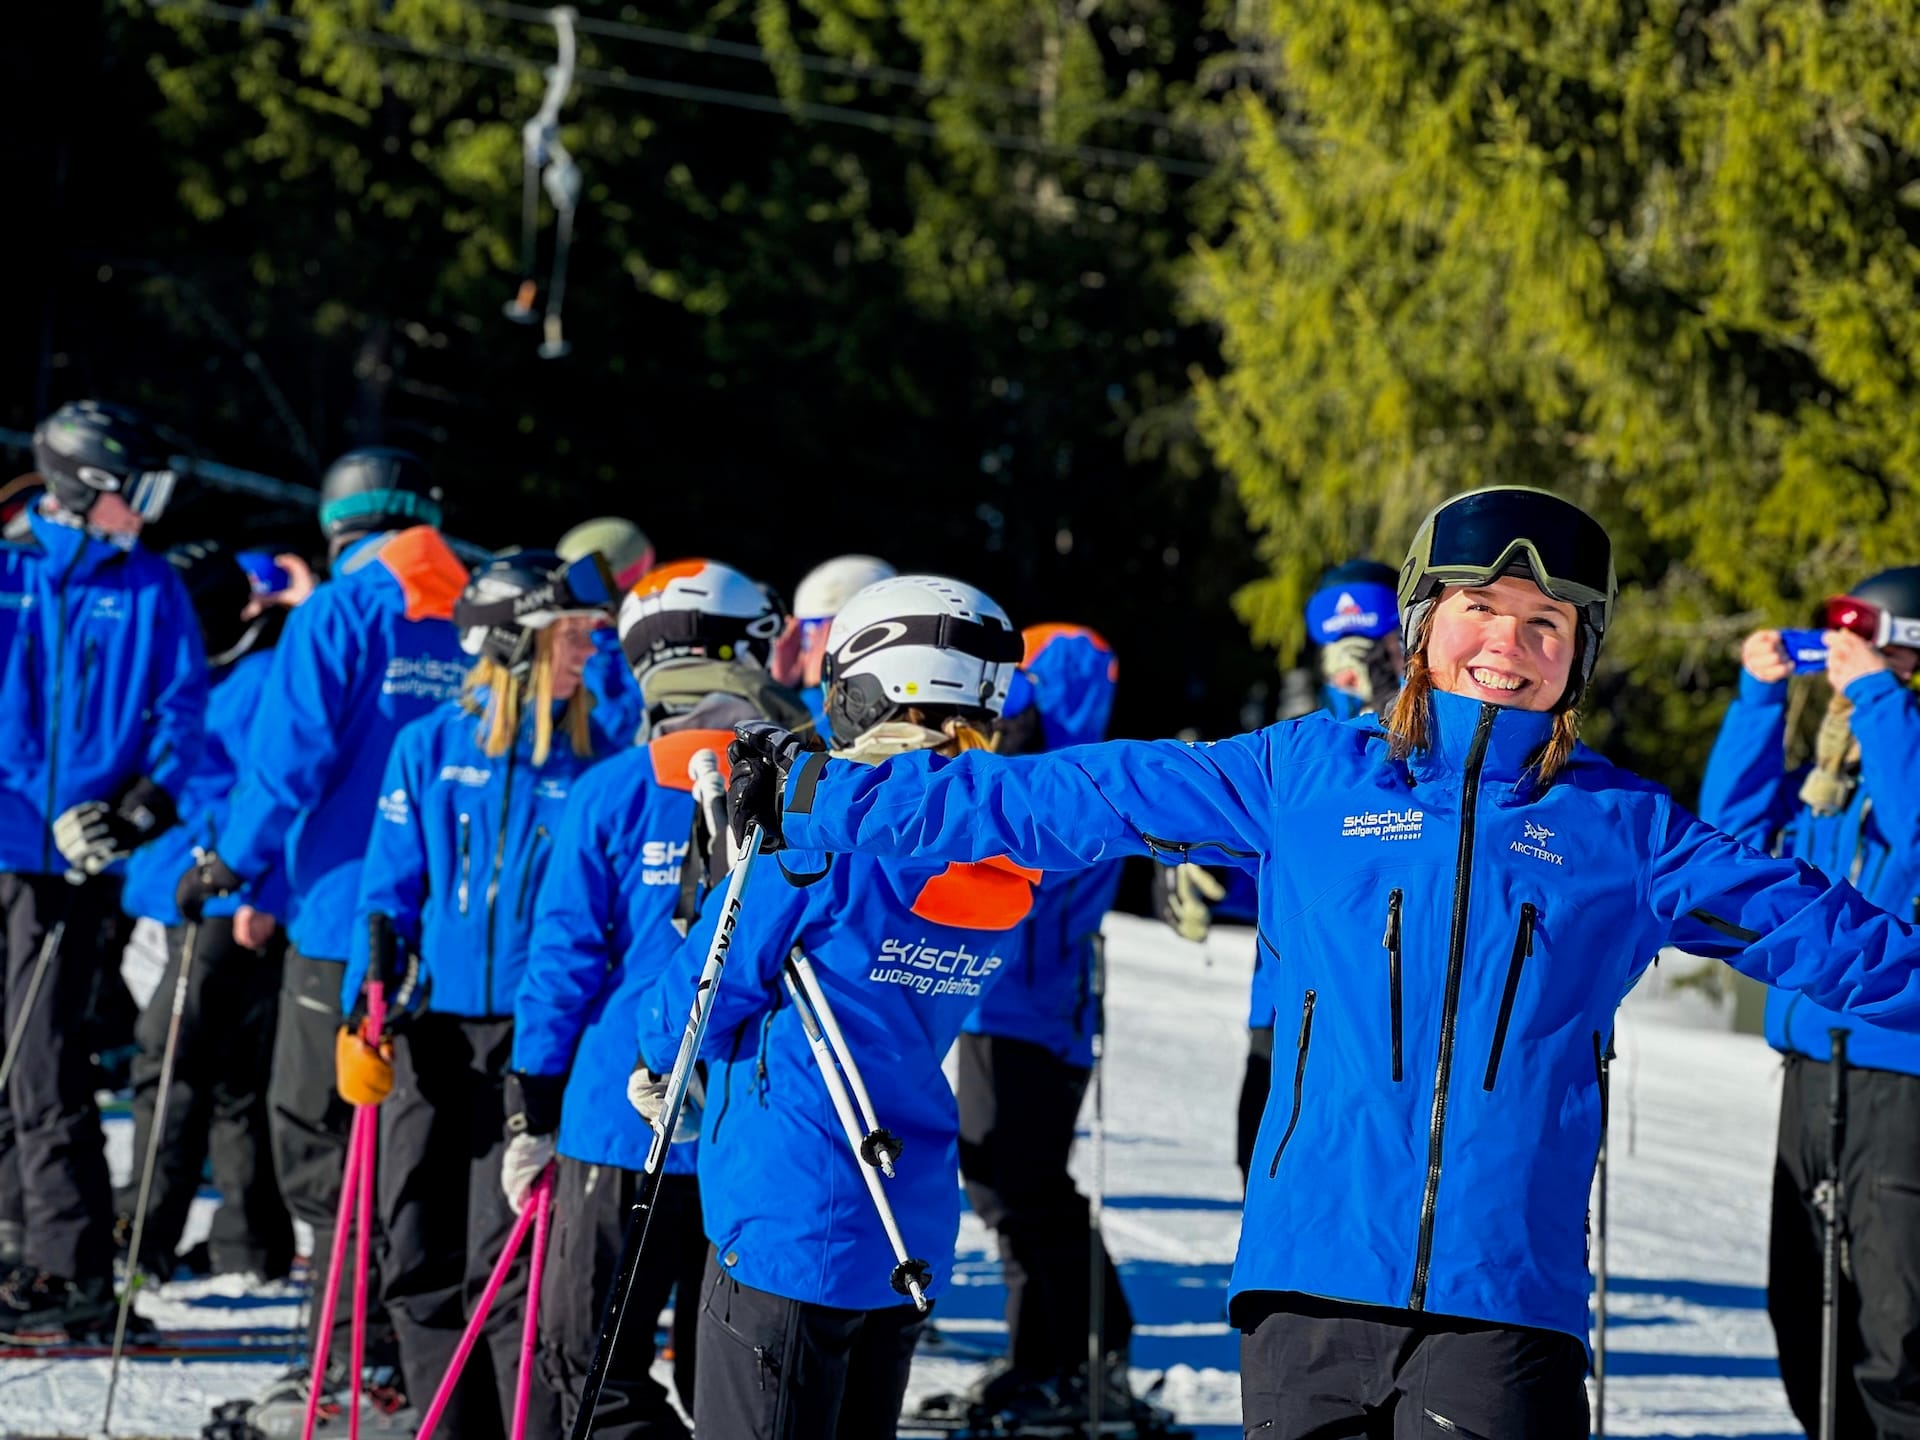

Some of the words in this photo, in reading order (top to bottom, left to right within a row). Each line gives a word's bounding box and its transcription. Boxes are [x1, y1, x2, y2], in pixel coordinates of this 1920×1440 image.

[1343, 808, 1424, 828] skischule
[1341, 826, 1381, 837] wolfgang
[1380, 833, 1422, 841] ALPENDORF
[877, 937, 1002, 977] skischue
[868, 968, 934, 994] woang
